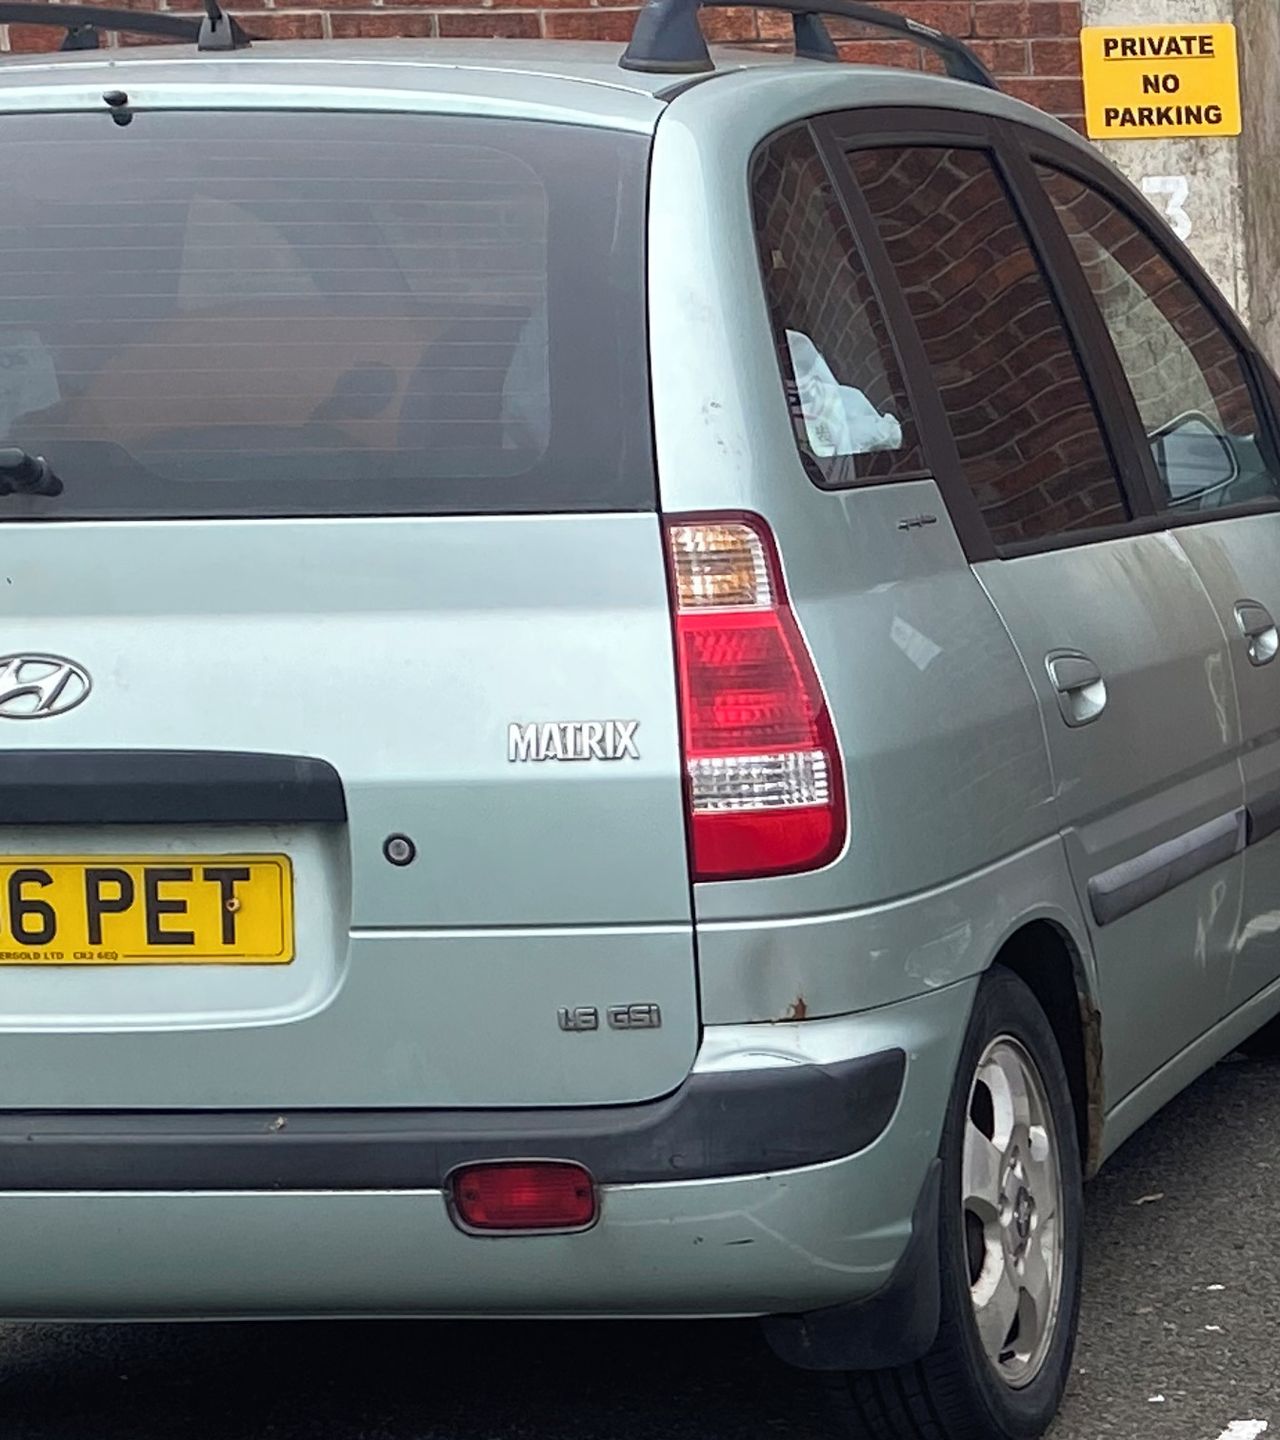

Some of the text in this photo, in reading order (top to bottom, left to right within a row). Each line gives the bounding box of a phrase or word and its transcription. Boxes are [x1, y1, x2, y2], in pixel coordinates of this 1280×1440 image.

[1103, 35, 1215, 58] PRIVATE
[1142, 74, 1180, 94] NO
[1104, 105, 1223, 127] PARKING
[508, 720, 640, 762] MATRIX
[84, 867, 251, 945] PET
[43, 951, 64, 960] LTD
